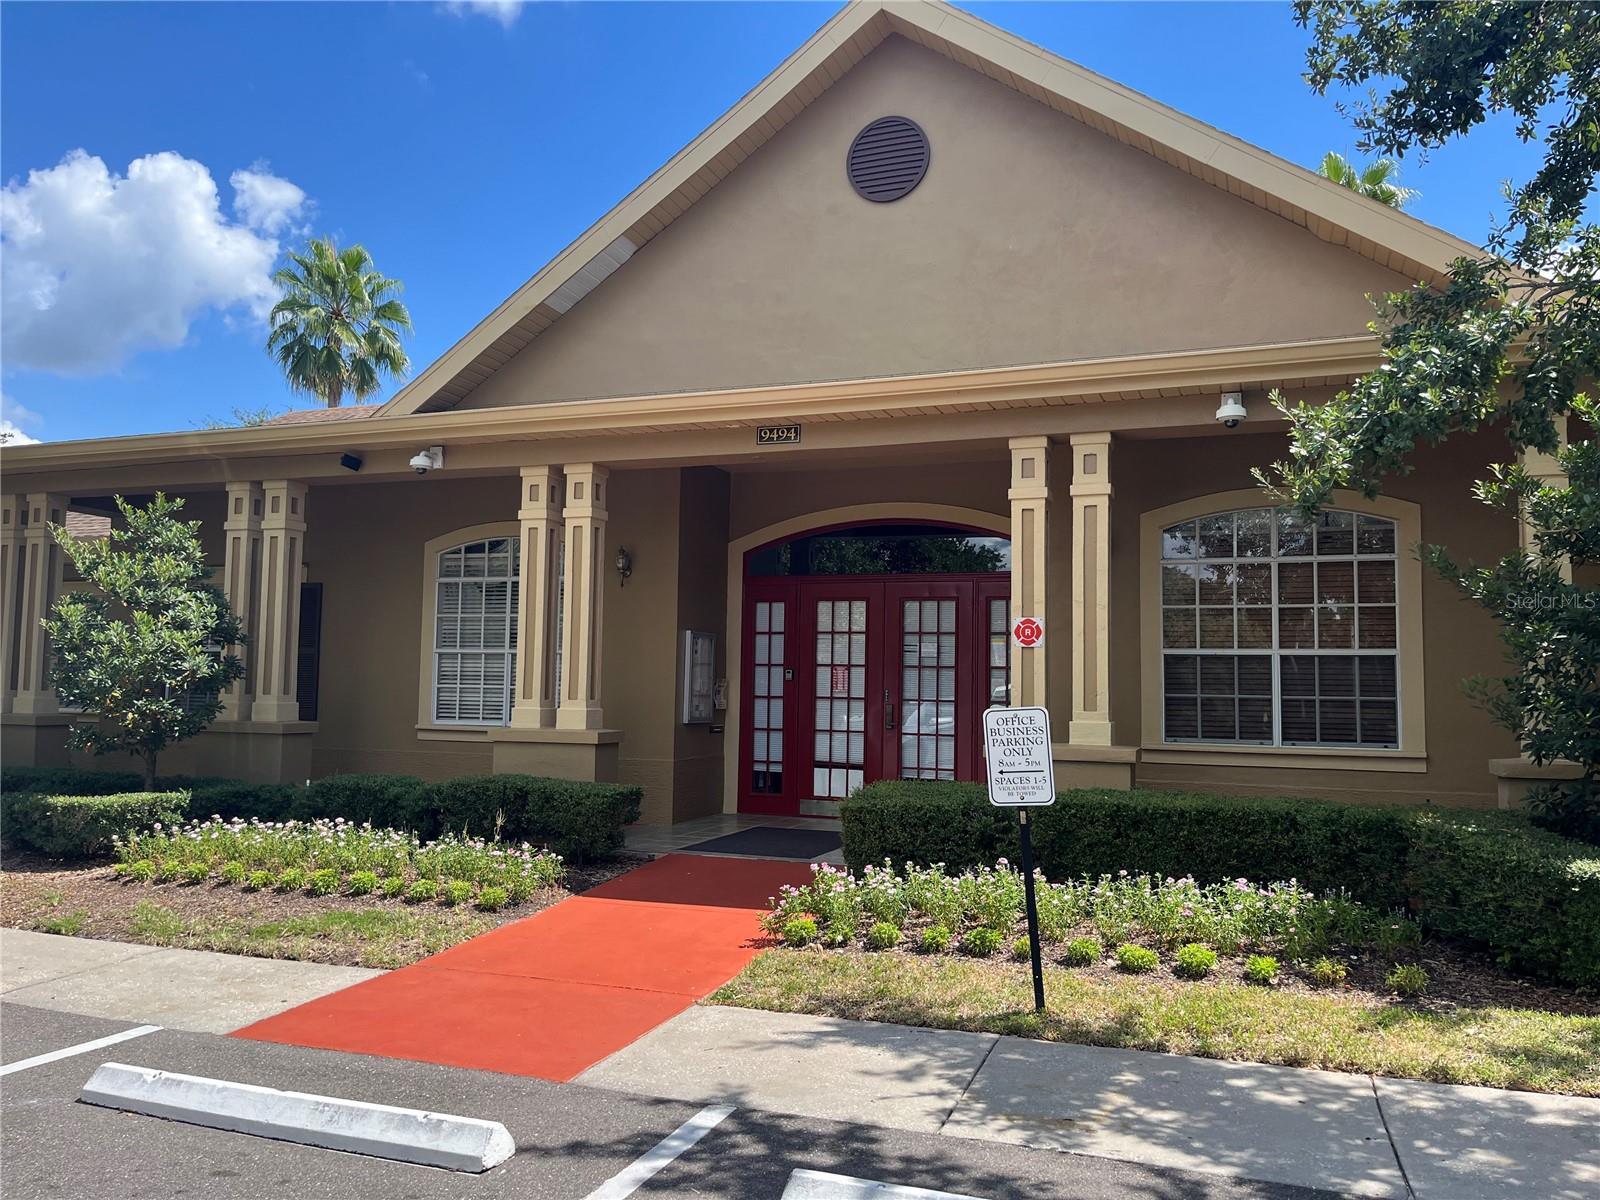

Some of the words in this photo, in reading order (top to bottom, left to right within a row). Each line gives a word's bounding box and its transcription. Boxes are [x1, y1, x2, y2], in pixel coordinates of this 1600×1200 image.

[761, 428, 796, 441] 9494
[996, 716, 1036, 726] OFFICE
[990, 726, 1045, 737] BUSINESS
[992, 737, 1044, 747] PARKING
[1003, 747, 1034, 757] ONLY
[998, 758, 1016, 768] 8AM
[1025, 758, 1041, 767] 5PM
[994, 777, 1031, 786] SPACES
[1034, 776, 1047, 784] 1-5
